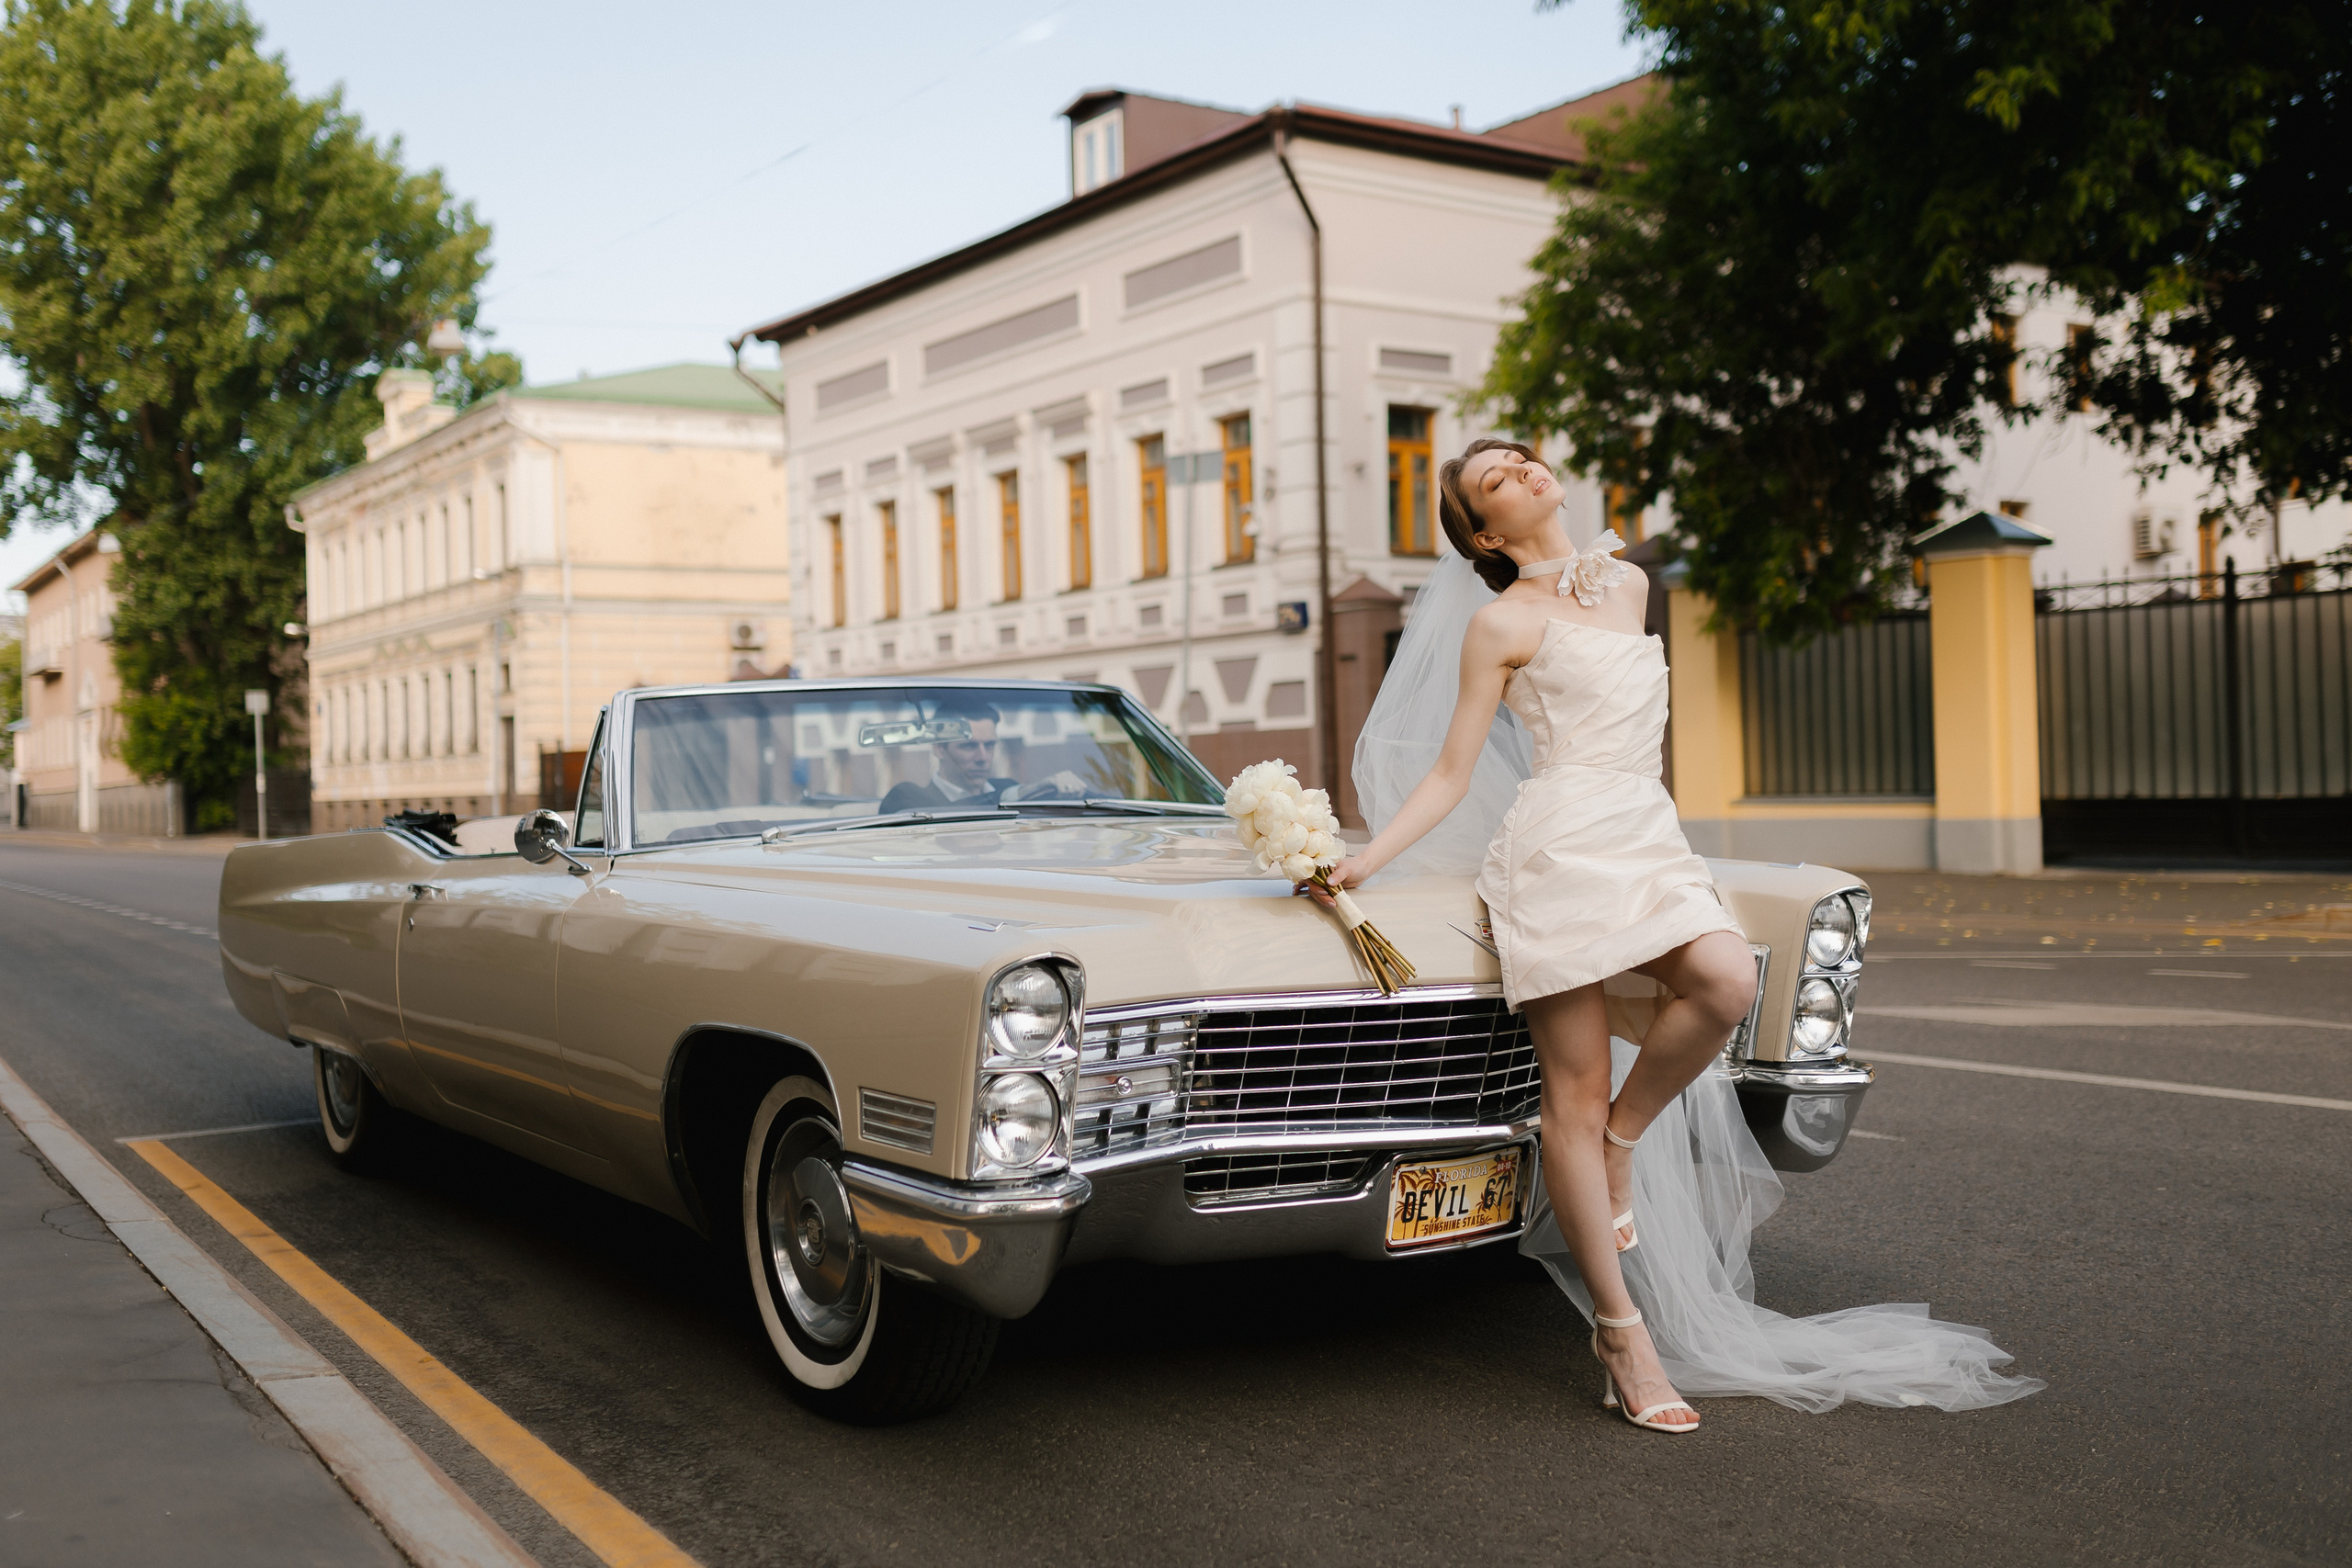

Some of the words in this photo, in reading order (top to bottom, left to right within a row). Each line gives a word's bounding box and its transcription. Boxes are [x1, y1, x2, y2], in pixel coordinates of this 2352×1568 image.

[1434, 1164, 1487, 1184] FLORIDA
[1402, 1184, 1469, 1224] DEVIL
[1484, 1175, 1509, 1210] 67
[1423, 1218, 1460, 1234] SUNSHINE
[1462, 1214, 1485, 1227] STATE
